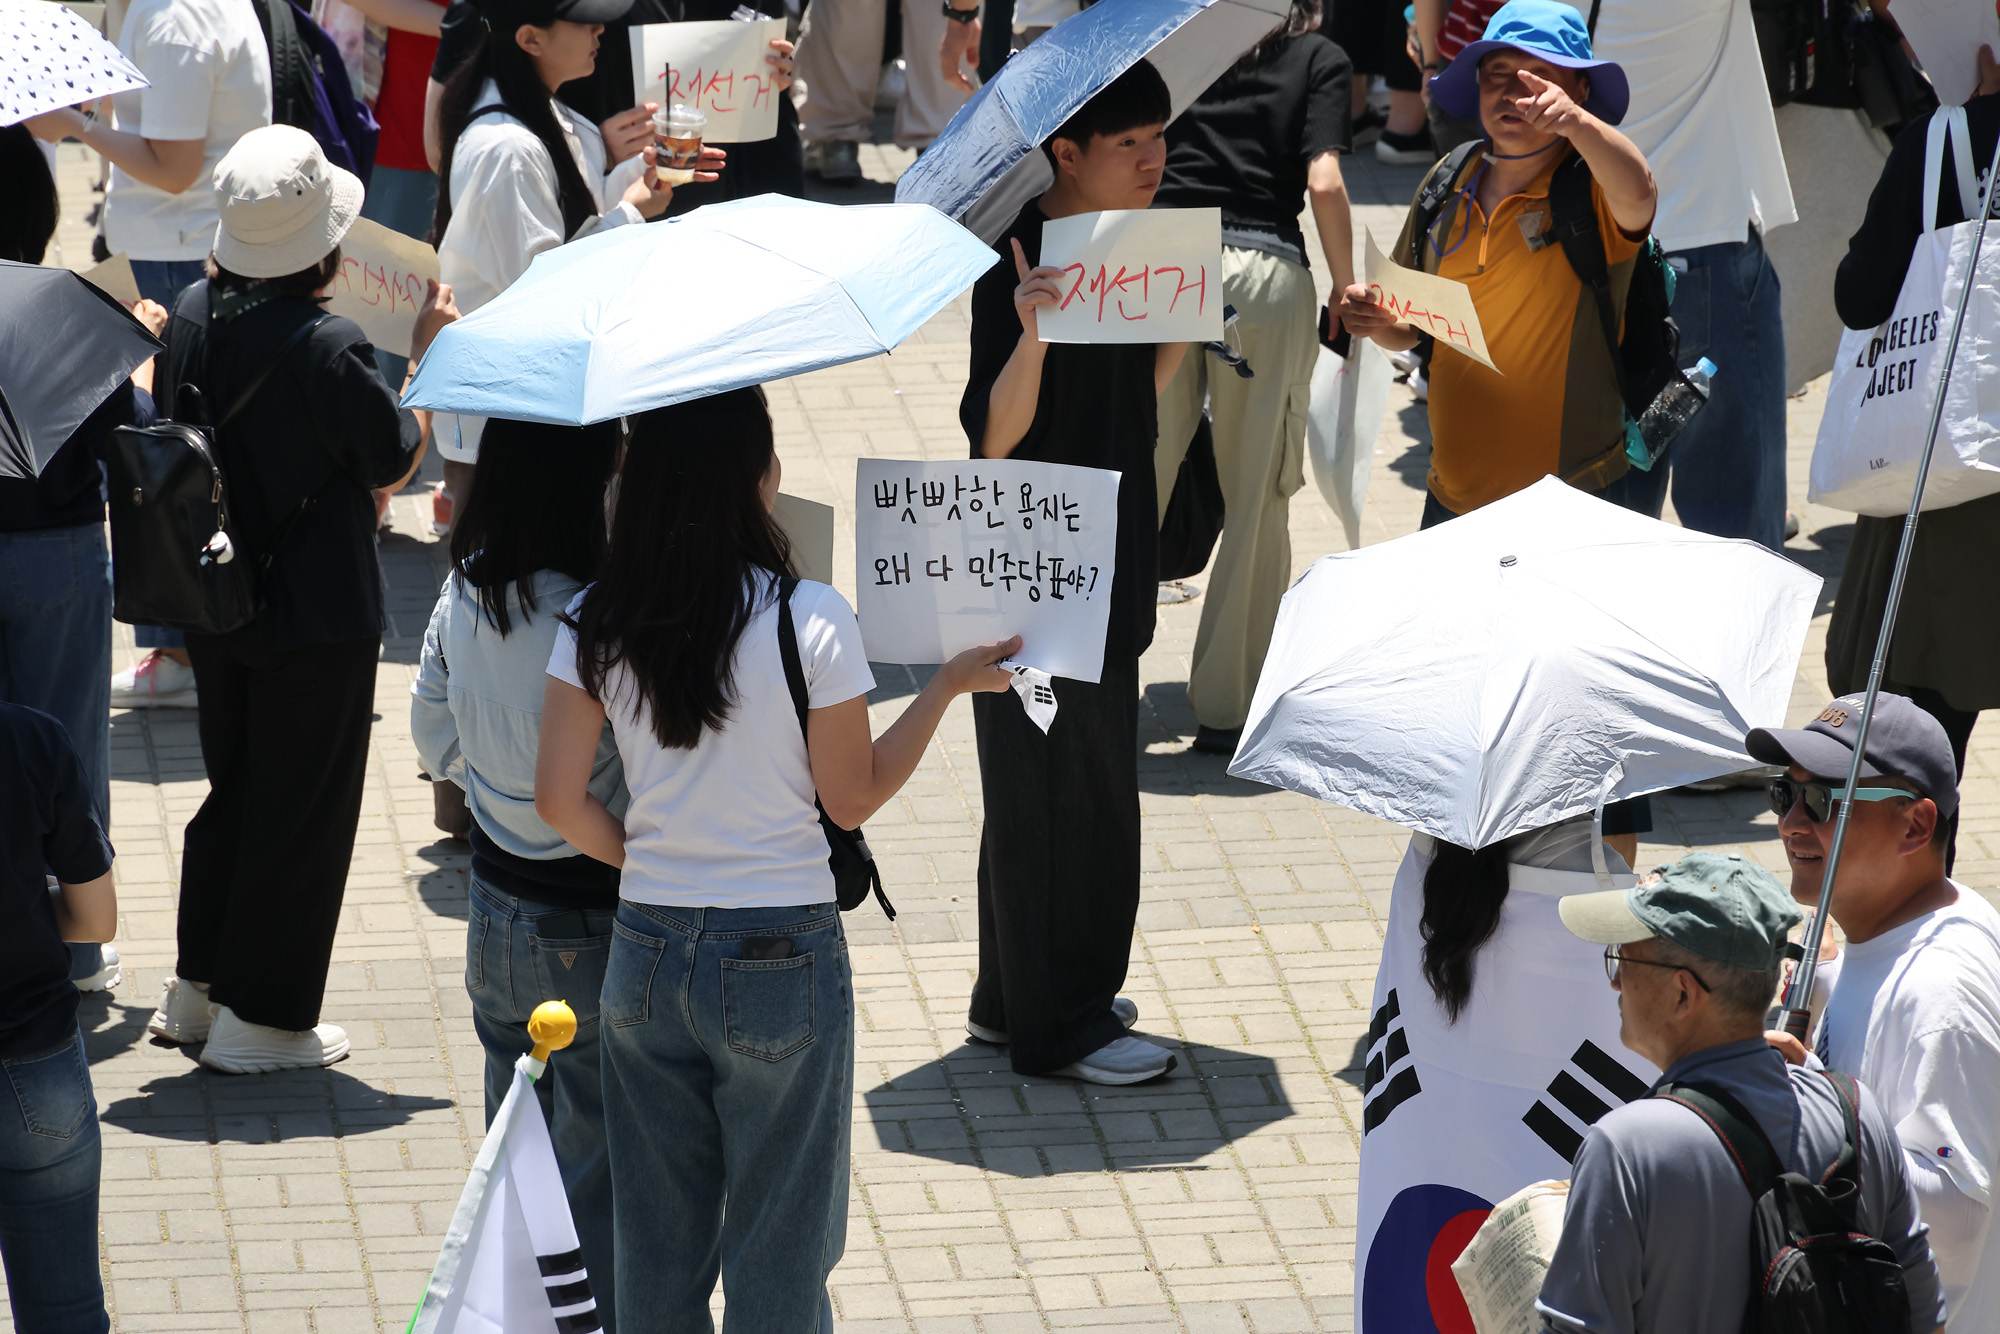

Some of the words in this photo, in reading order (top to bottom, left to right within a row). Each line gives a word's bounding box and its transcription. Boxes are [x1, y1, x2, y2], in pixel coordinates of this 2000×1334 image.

[658, 68, 774, 112] 재선거
[1060, 262, 1206, 323] 재선거
[874, 474, 1005, 528] 빳빳한
[1018, 482, 1080, 532] 용지는
[874, 552, 911, 586] 왜
[925, 554, 954, 582] 다
[968, 547, 1099, 603] 민주당표야?
